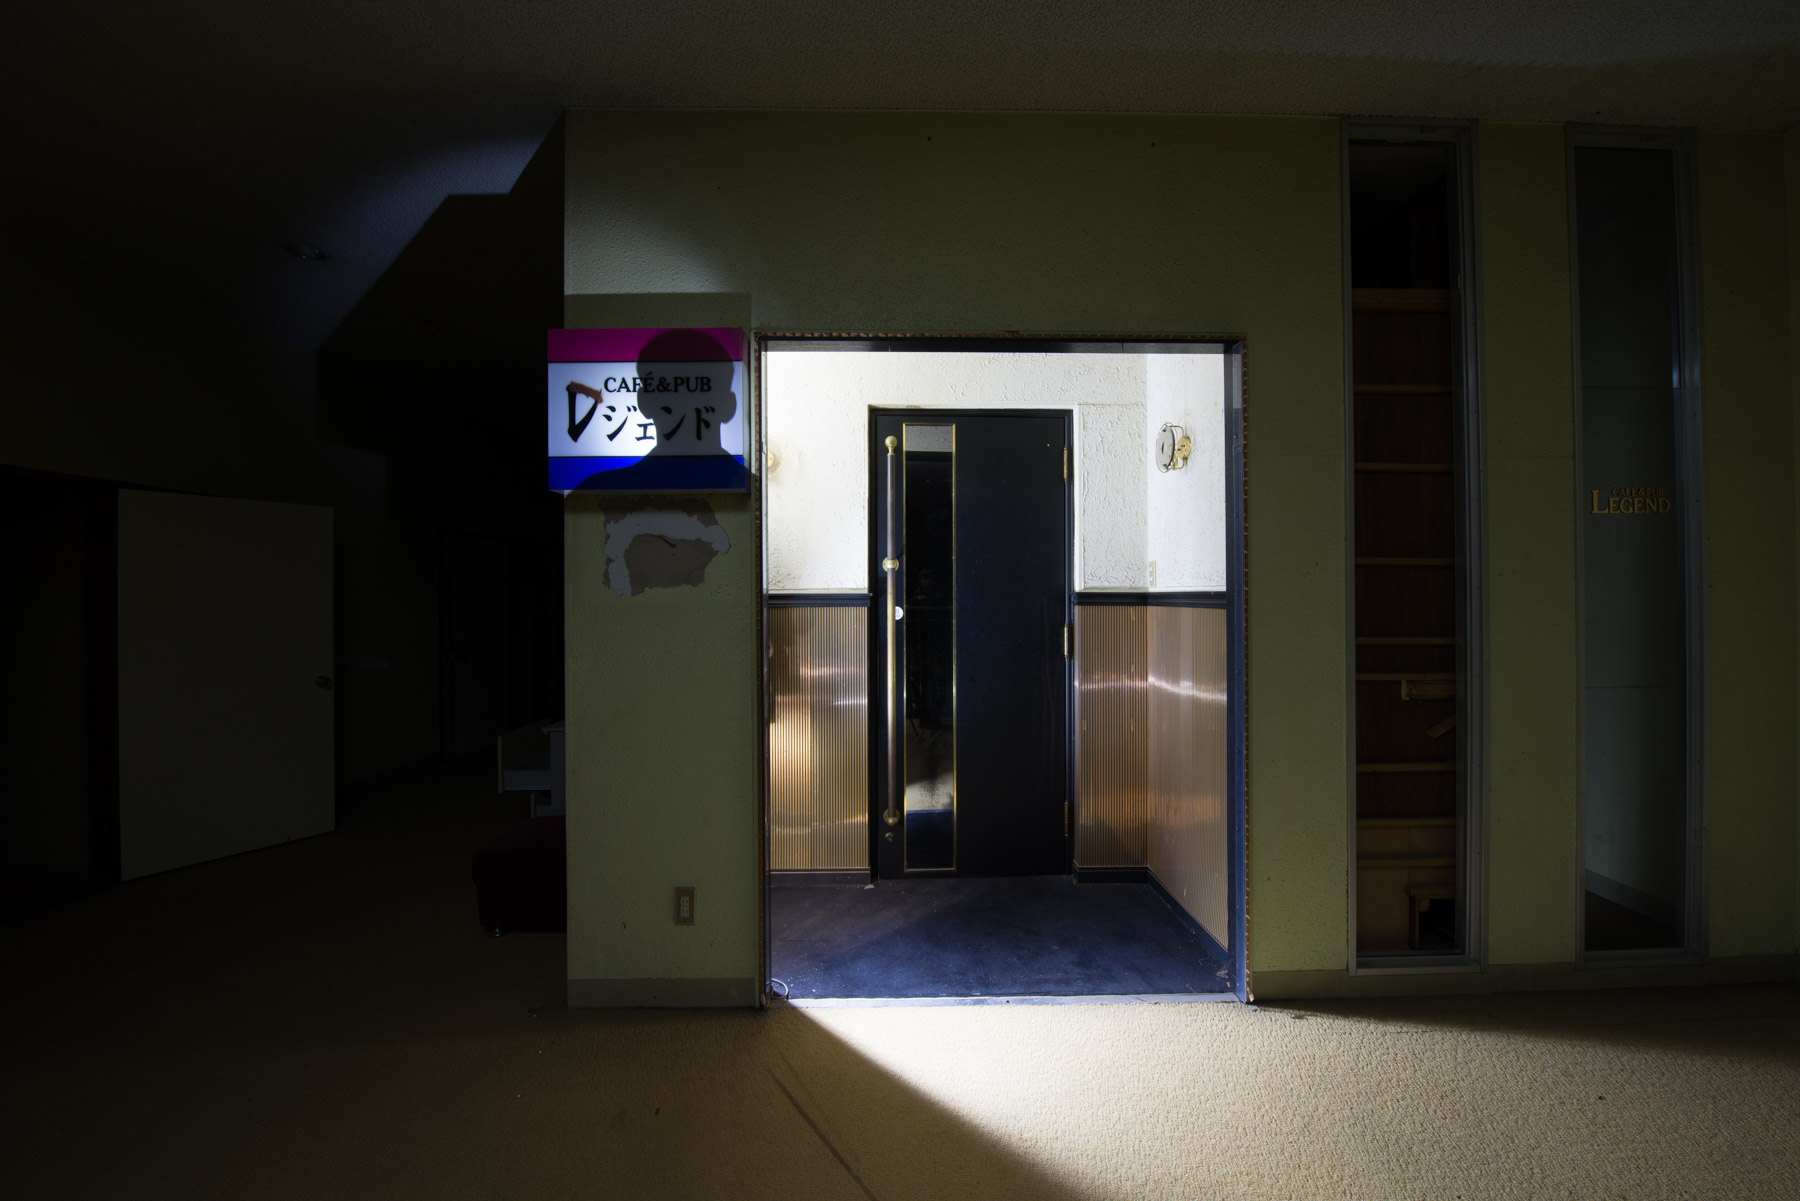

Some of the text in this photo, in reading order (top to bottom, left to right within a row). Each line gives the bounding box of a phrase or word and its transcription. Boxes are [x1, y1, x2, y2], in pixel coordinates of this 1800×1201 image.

[604, 372, 712, 393] CAFÉ&PUB
[566, 381, 715, 442] レジェンド
[1592, 489, 1671, 514] LEGEND
